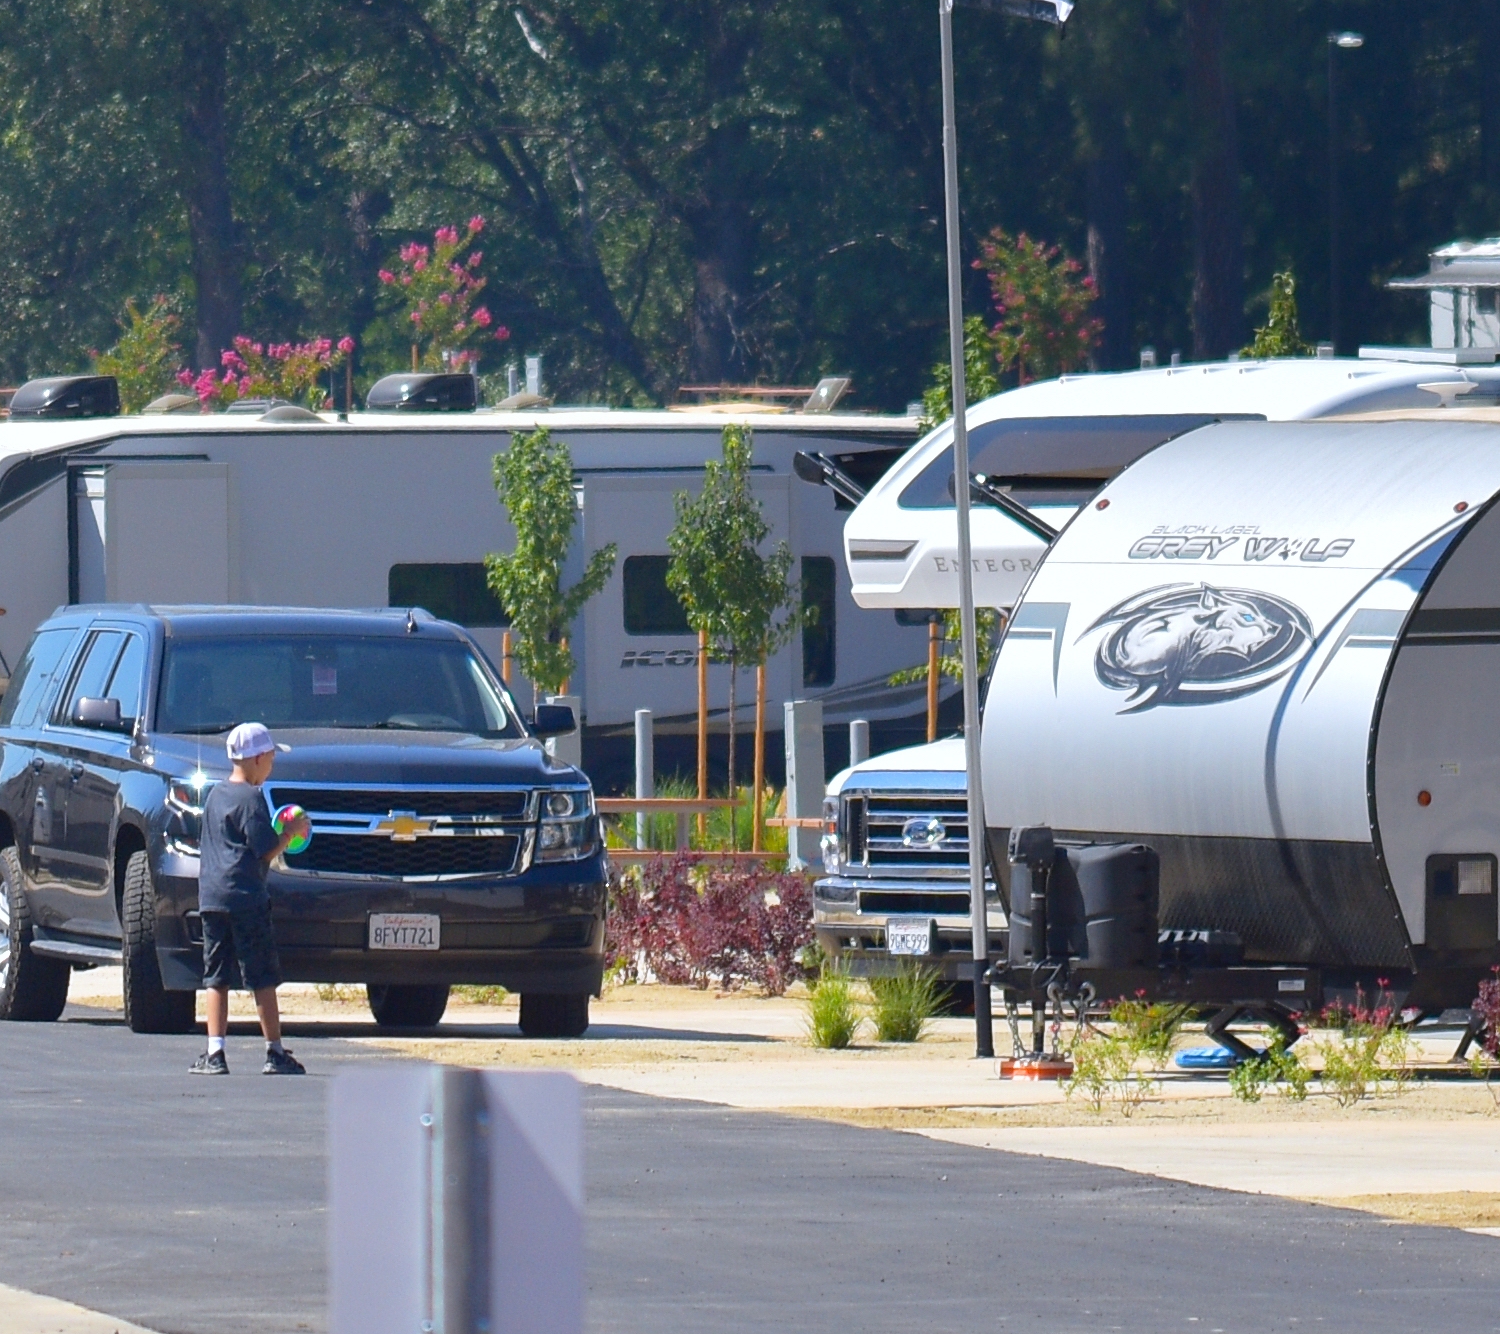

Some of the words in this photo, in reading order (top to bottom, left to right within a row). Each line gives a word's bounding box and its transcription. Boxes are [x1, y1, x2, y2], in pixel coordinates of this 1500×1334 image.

[1151, 525, 1209, 535] BLACK
[1210, 525, 1262, 535] LABEL
[1128, 535, 1240, 560] GREY
[373, 927, 435, 946] 8FYT721
